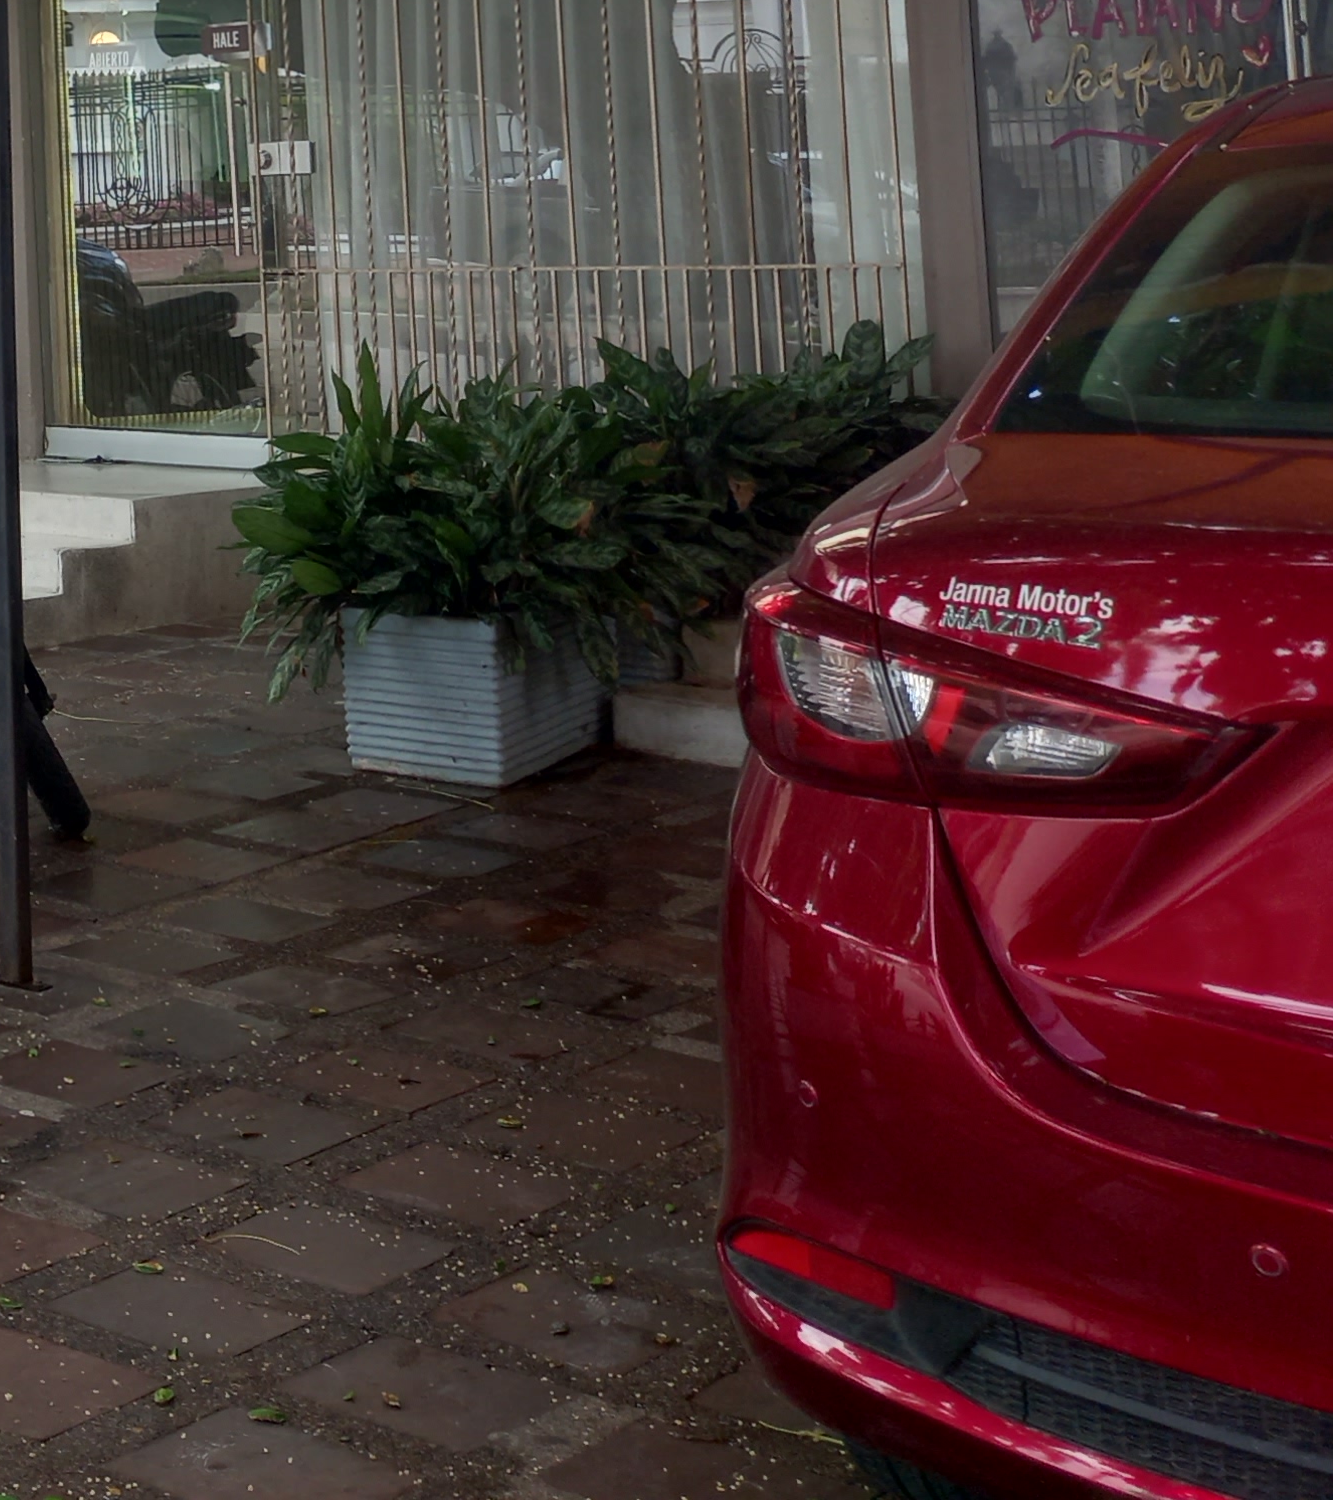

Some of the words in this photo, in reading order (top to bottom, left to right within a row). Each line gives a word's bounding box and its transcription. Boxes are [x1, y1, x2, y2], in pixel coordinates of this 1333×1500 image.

[212, 30, 240, 49] HALE
[89, 50, 130, 68] ABIERTO
[1045, 44, 1126, 107] Sea
[1123, 44, 1244, 122] feliz
[939, 576, 1010, 608] Janna
[1017, 584, 1114, 619] Motor's
